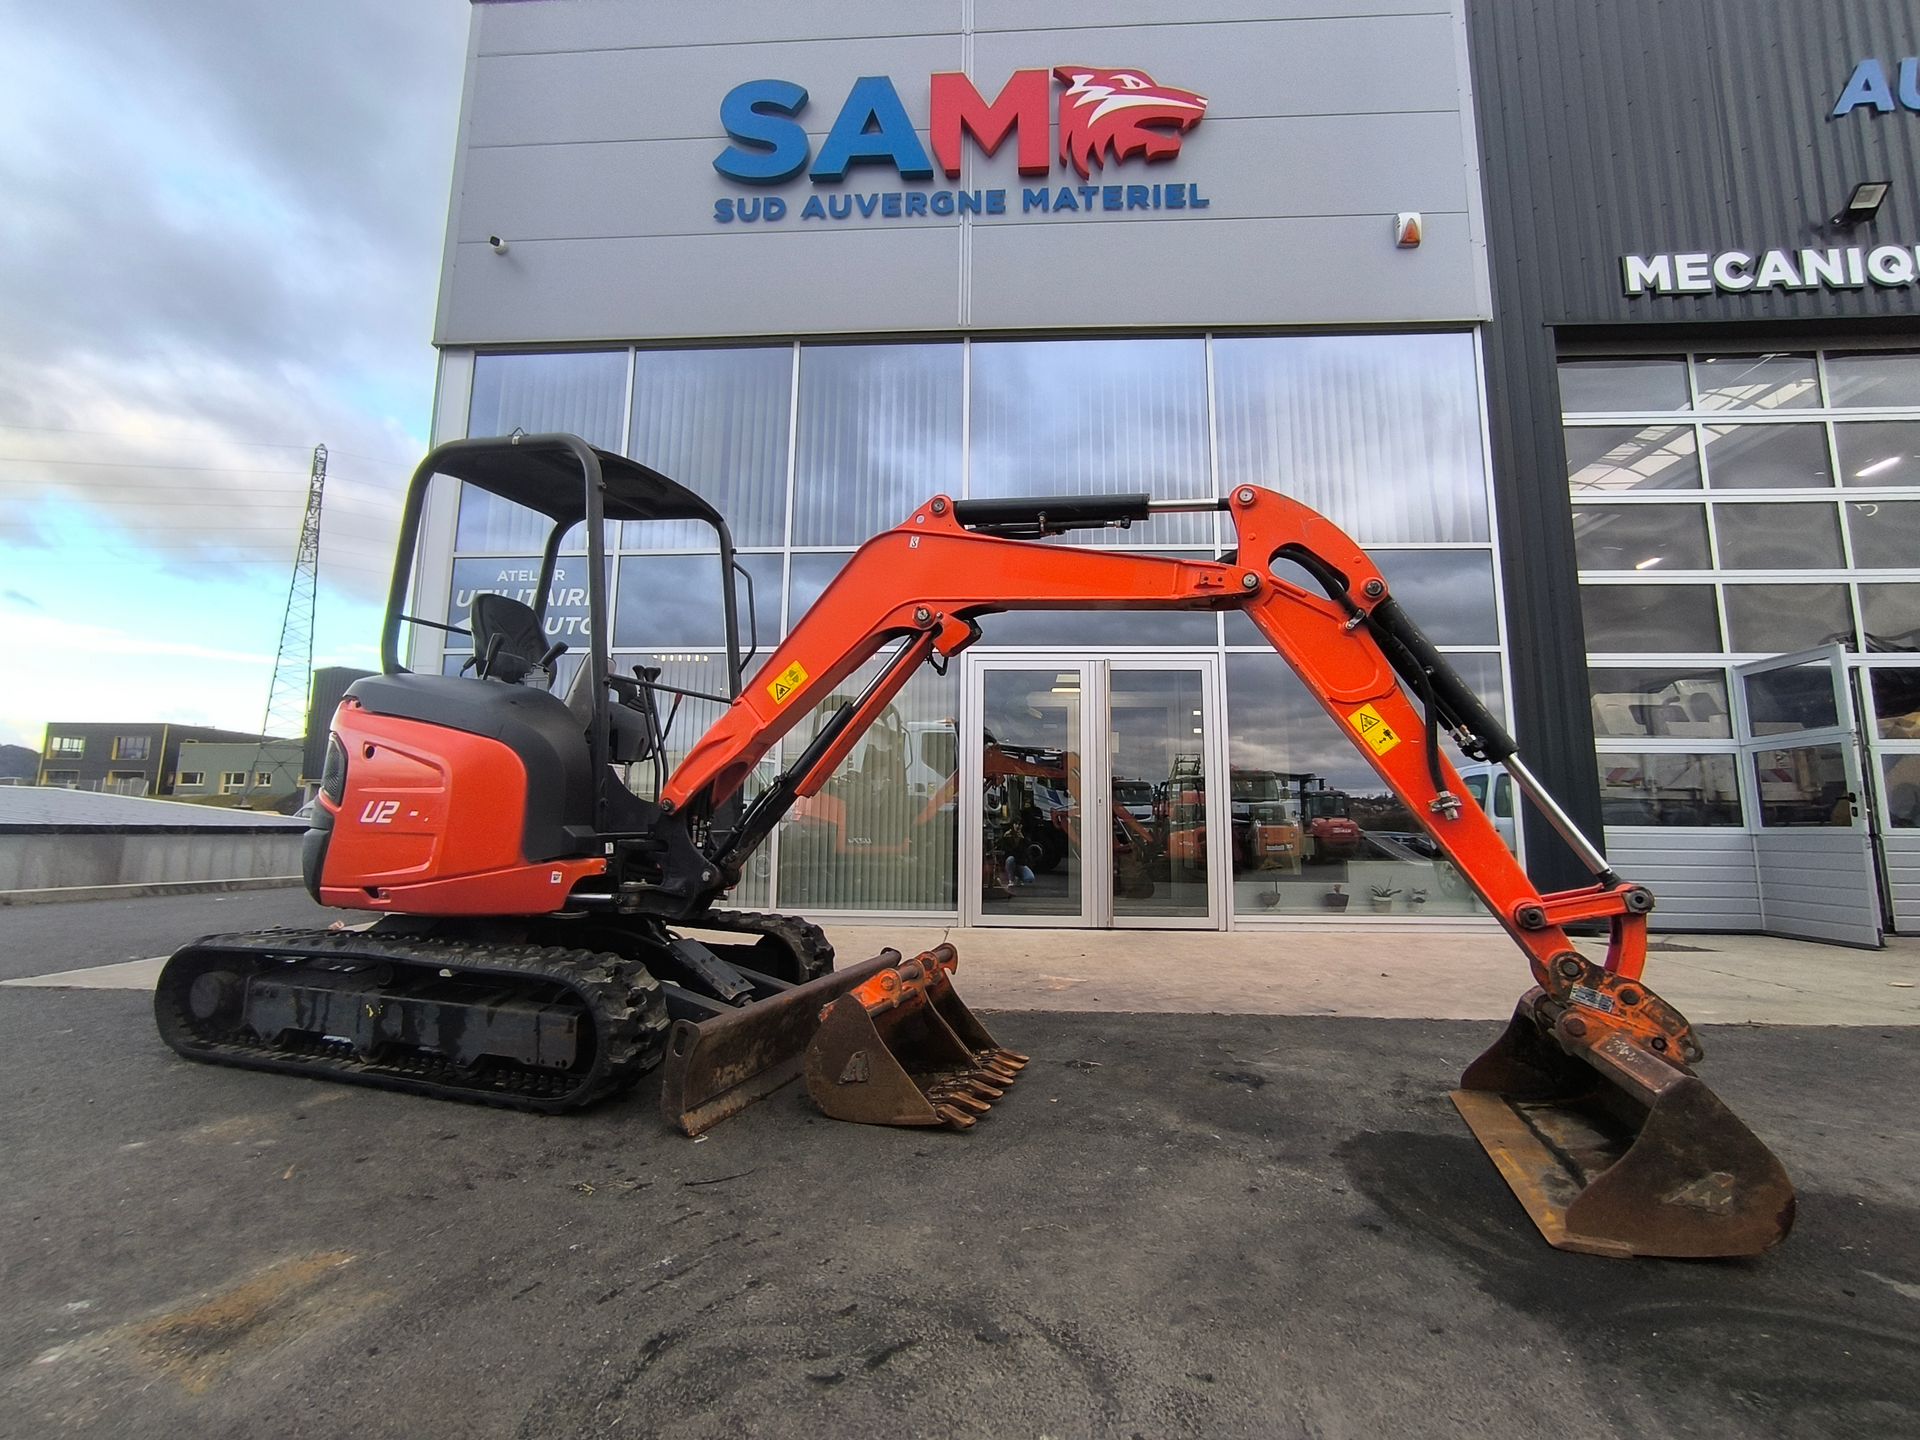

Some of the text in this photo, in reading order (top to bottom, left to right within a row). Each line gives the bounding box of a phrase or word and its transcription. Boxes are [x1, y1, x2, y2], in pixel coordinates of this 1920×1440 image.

[713, 69, 1050, 183] SAM
[713, 182, 1210, 223] SUD AUVERGNE MATERIEL
[1624, 245, 1920, 293] MECANIQ
[496, 569, 566, 582] ATELR
